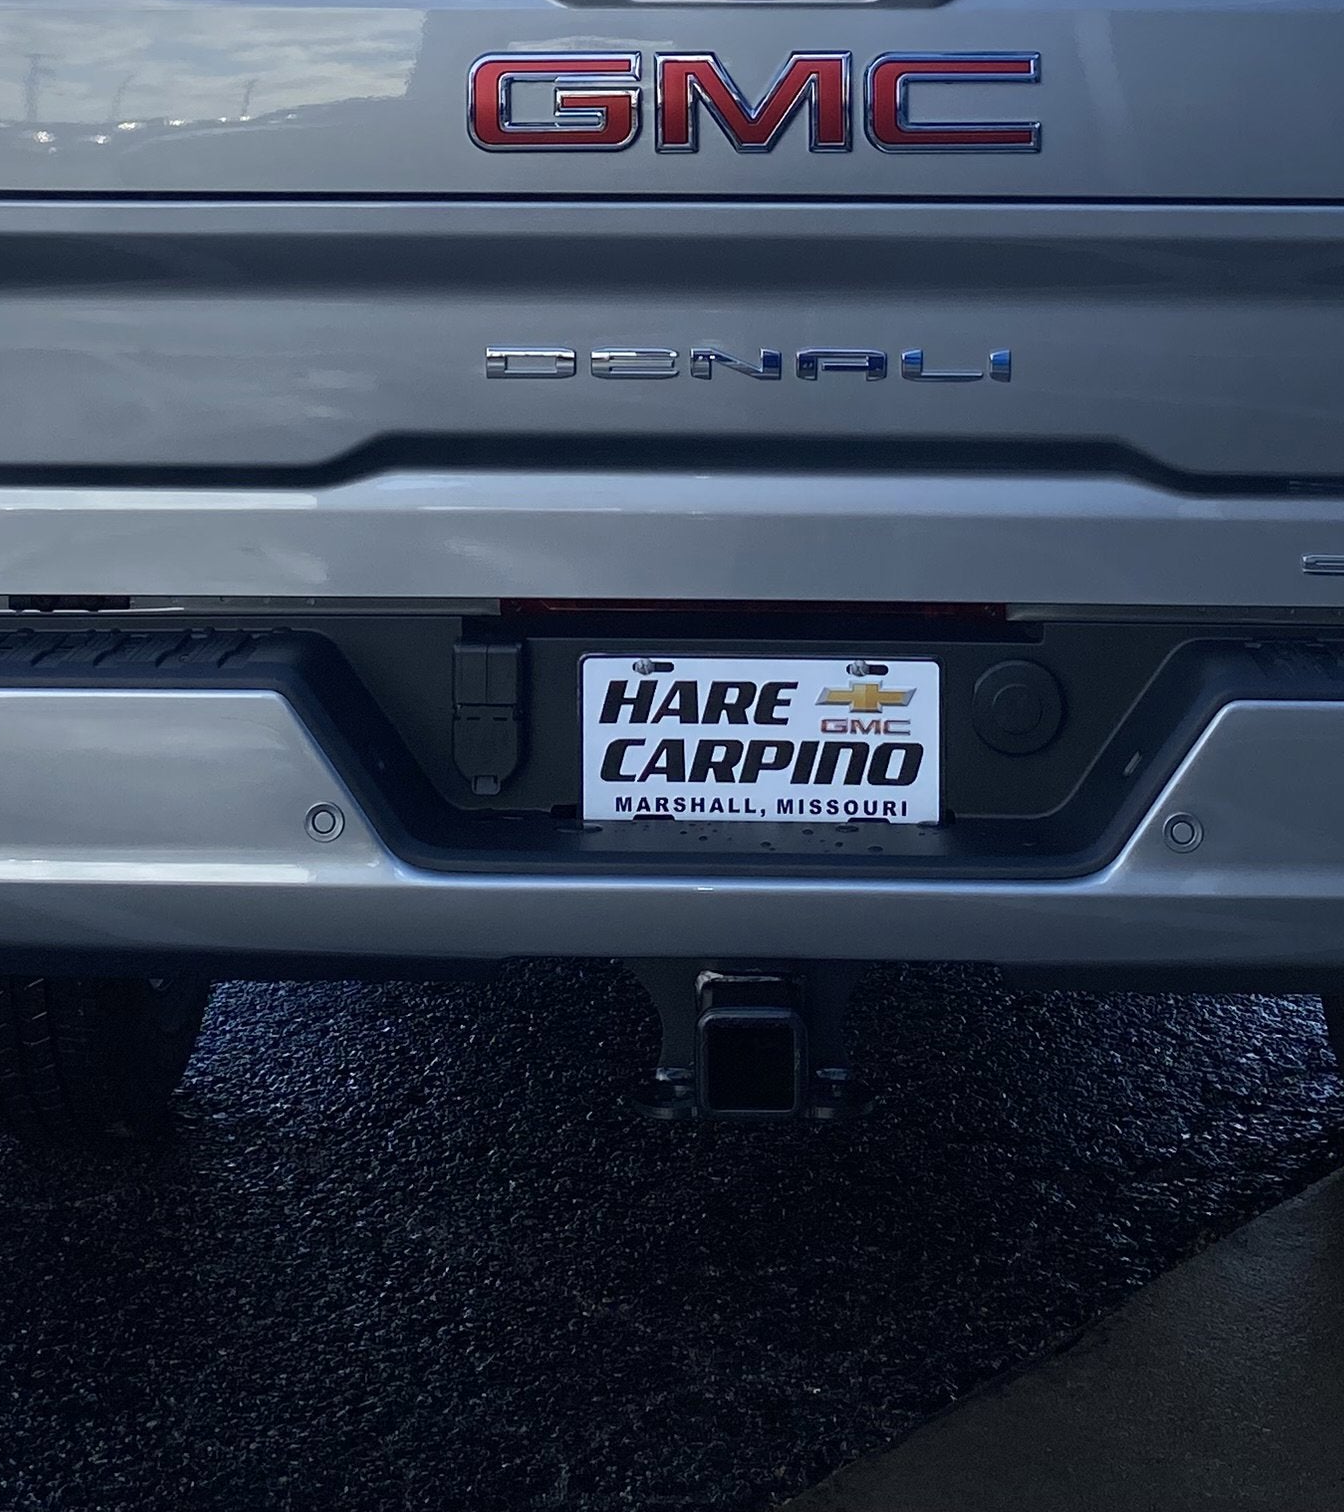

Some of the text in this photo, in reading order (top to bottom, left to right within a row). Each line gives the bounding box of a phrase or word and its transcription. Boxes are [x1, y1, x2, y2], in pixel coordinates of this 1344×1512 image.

[467, 50, 1041, 153] GMC
[485, 347, 1012, 381] DENALI
[599, 680, 799, 726] HARE
[820, 718, 911, 735] GMC
[600, 738, 924, 786] CARPINO
[615, 796, 908, 817] MARSHALL, MISSOURI
